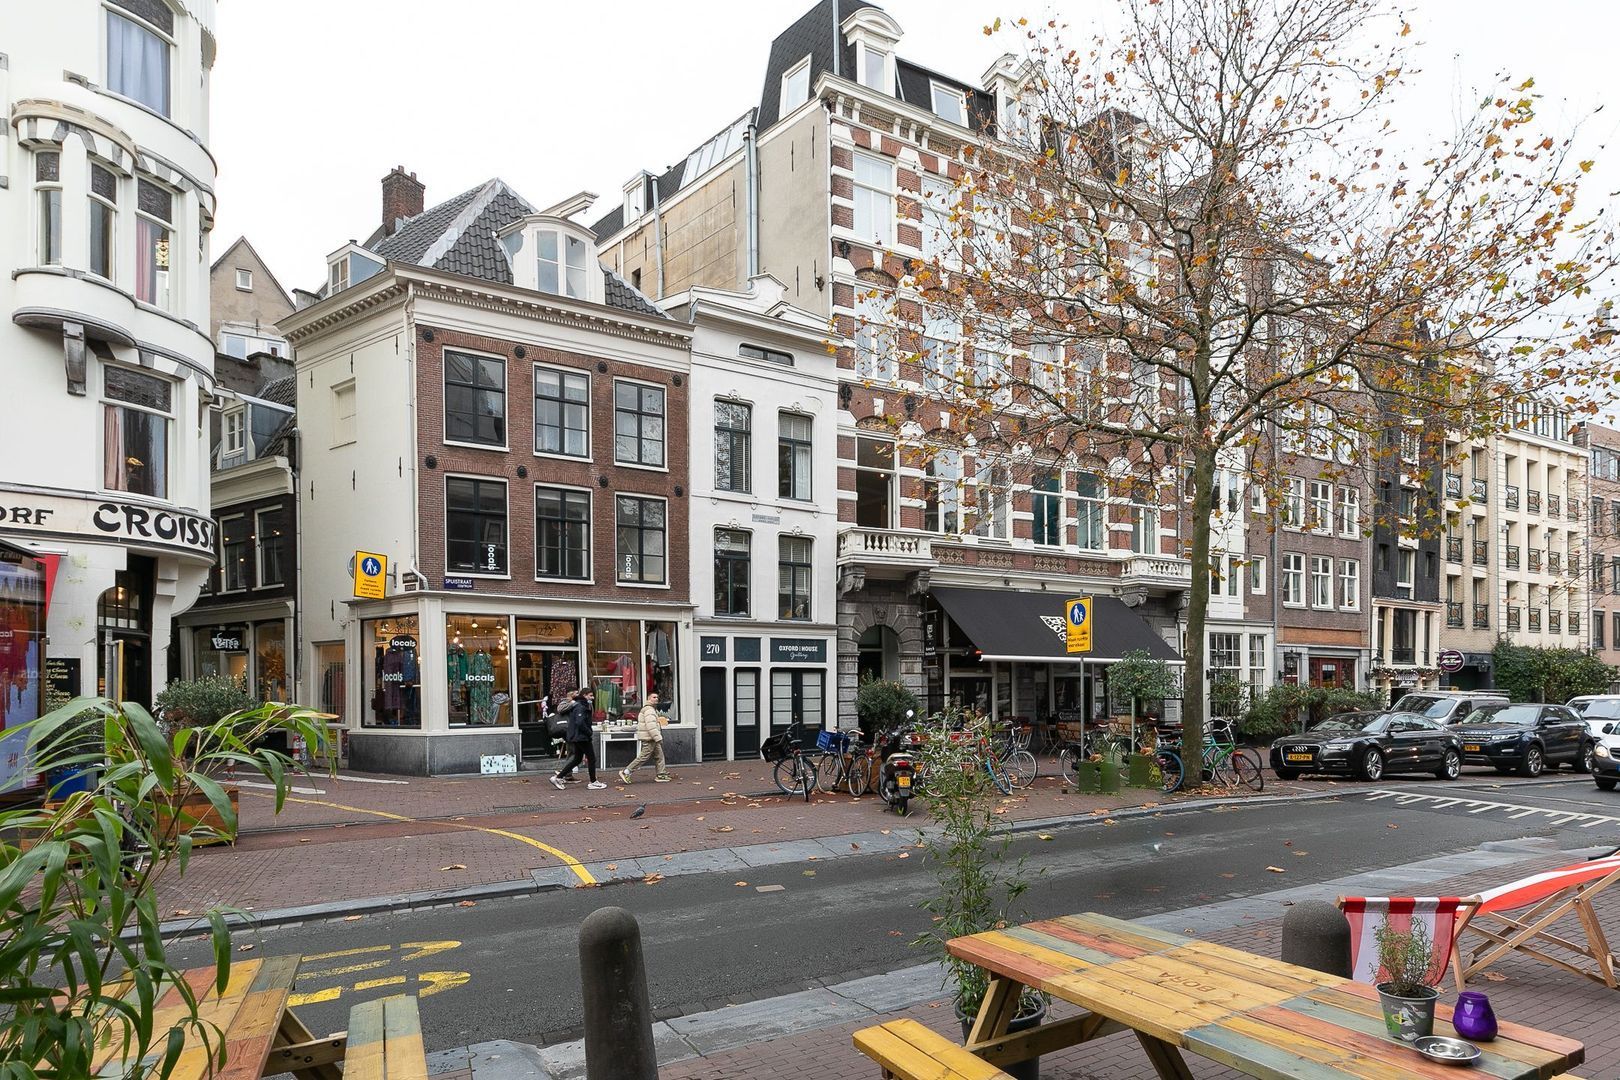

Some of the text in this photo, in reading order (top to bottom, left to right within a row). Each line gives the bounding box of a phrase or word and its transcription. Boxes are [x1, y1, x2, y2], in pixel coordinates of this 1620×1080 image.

[488, 544, 497, 570] locals
[625, 554, 633, 578] locals
[391, 638, 417, 648] locals
[706, 643, 720, 654] 270
[382, 671, 403, 682] locals
[465, 673, 495, 682] locals
